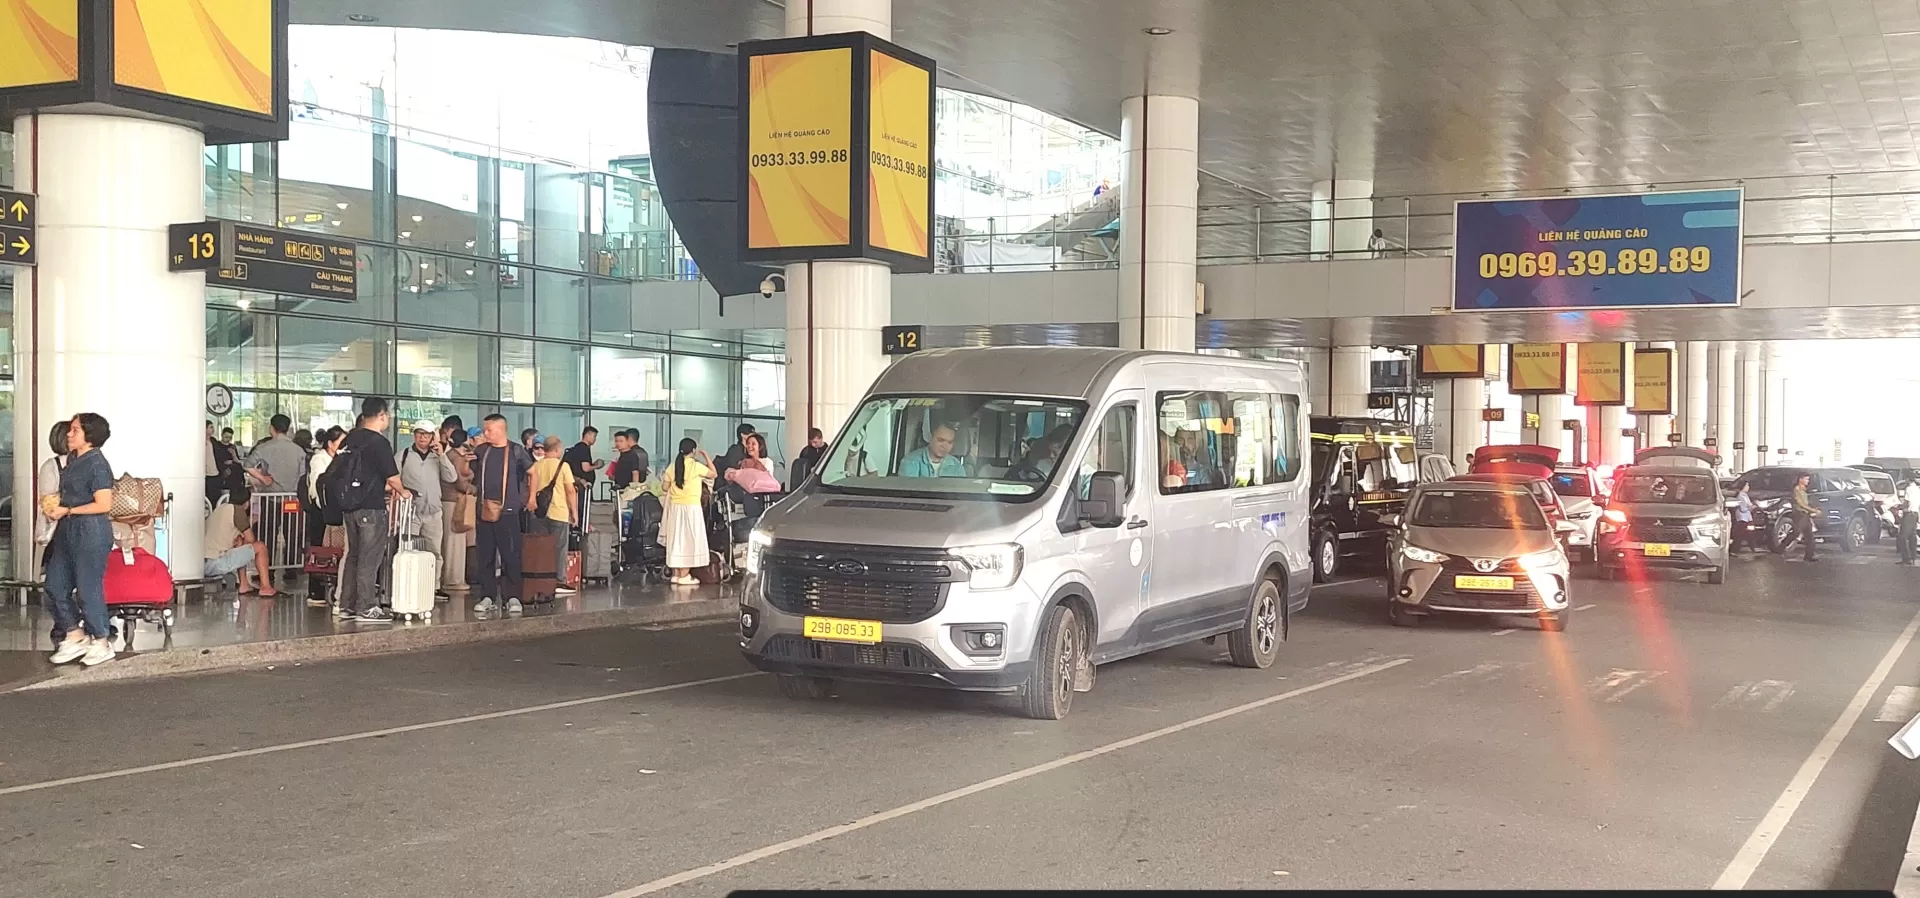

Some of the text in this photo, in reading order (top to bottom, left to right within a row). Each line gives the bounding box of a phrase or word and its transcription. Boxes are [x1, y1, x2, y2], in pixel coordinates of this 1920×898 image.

[752, 149, 848, 168] 0933.33.99.88
[871, 150, 927, 179] 0933.33.99.88
[1538, 226, 1648, 243] LIÊN HỆ QUẢNG CÁO
[188, 232, 215, 260] 13
[173, 254, 184, 265] 1F
[1479, 246, 1711, 279] 0969.39.89.89
[331, 273, 354, 284] THANG
[897, 331, 917, 348] 12
[1377, 396, 1391, 406] 10
[1490, 411, 1503, 419] 09
[811, 621, 874, 637] 29B-085.33
